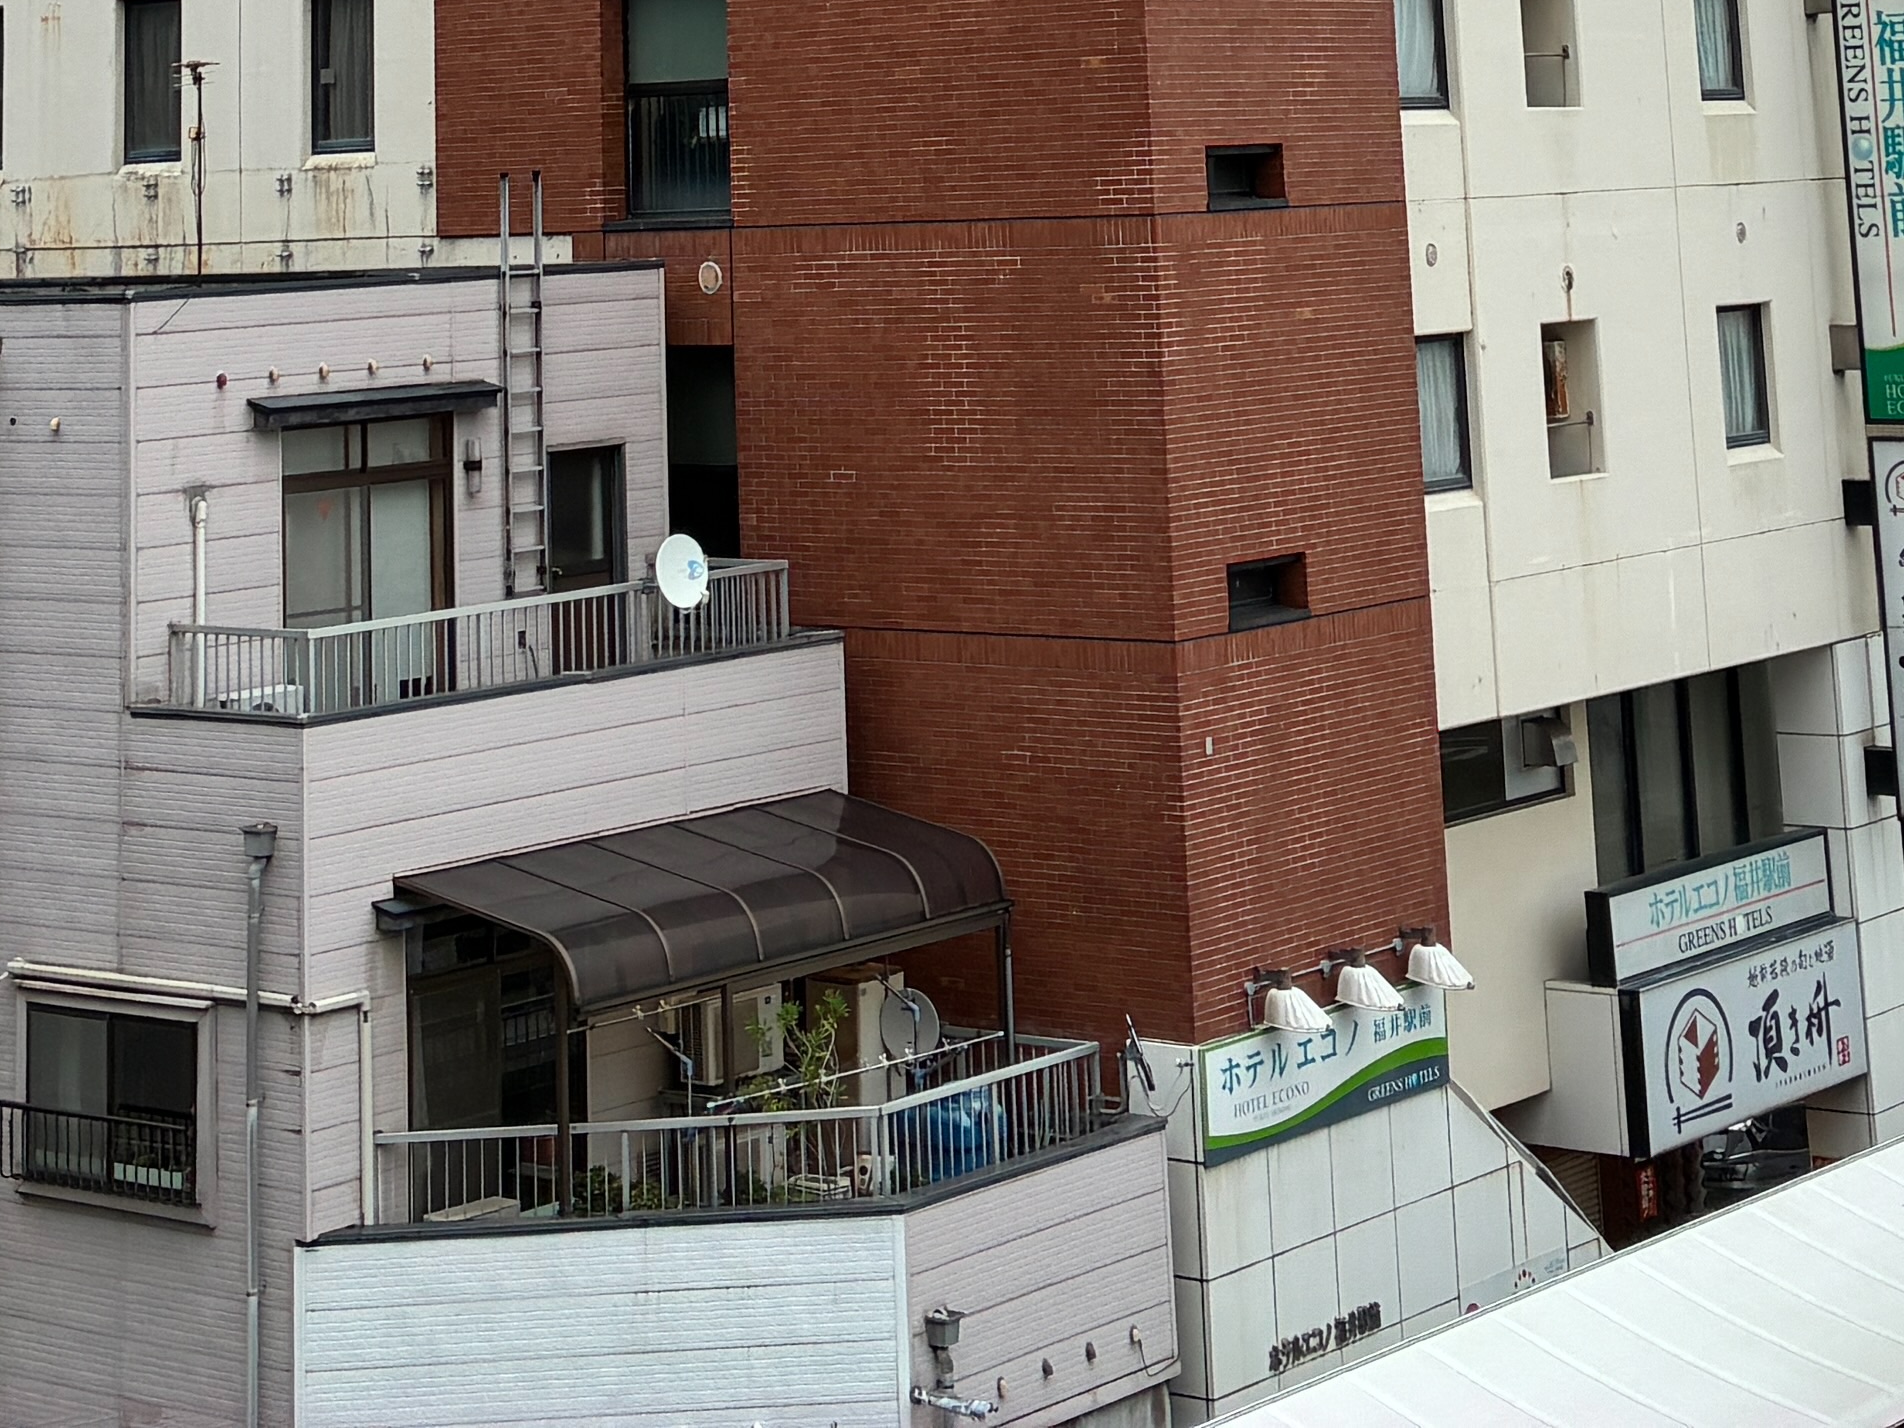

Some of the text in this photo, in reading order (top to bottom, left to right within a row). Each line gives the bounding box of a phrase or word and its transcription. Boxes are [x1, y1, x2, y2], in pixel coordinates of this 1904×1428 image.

[1679, 918, 1726, 954] GREENS
[1220, 1003, 1432, 1095] ホテルエコノ 福井駅前
[1234, 1093, 1270, 1119] HOTEL
[1272, 1080, 1310, 1106] ECONO
[1368, 1077, 1405, 1102] GREENS
